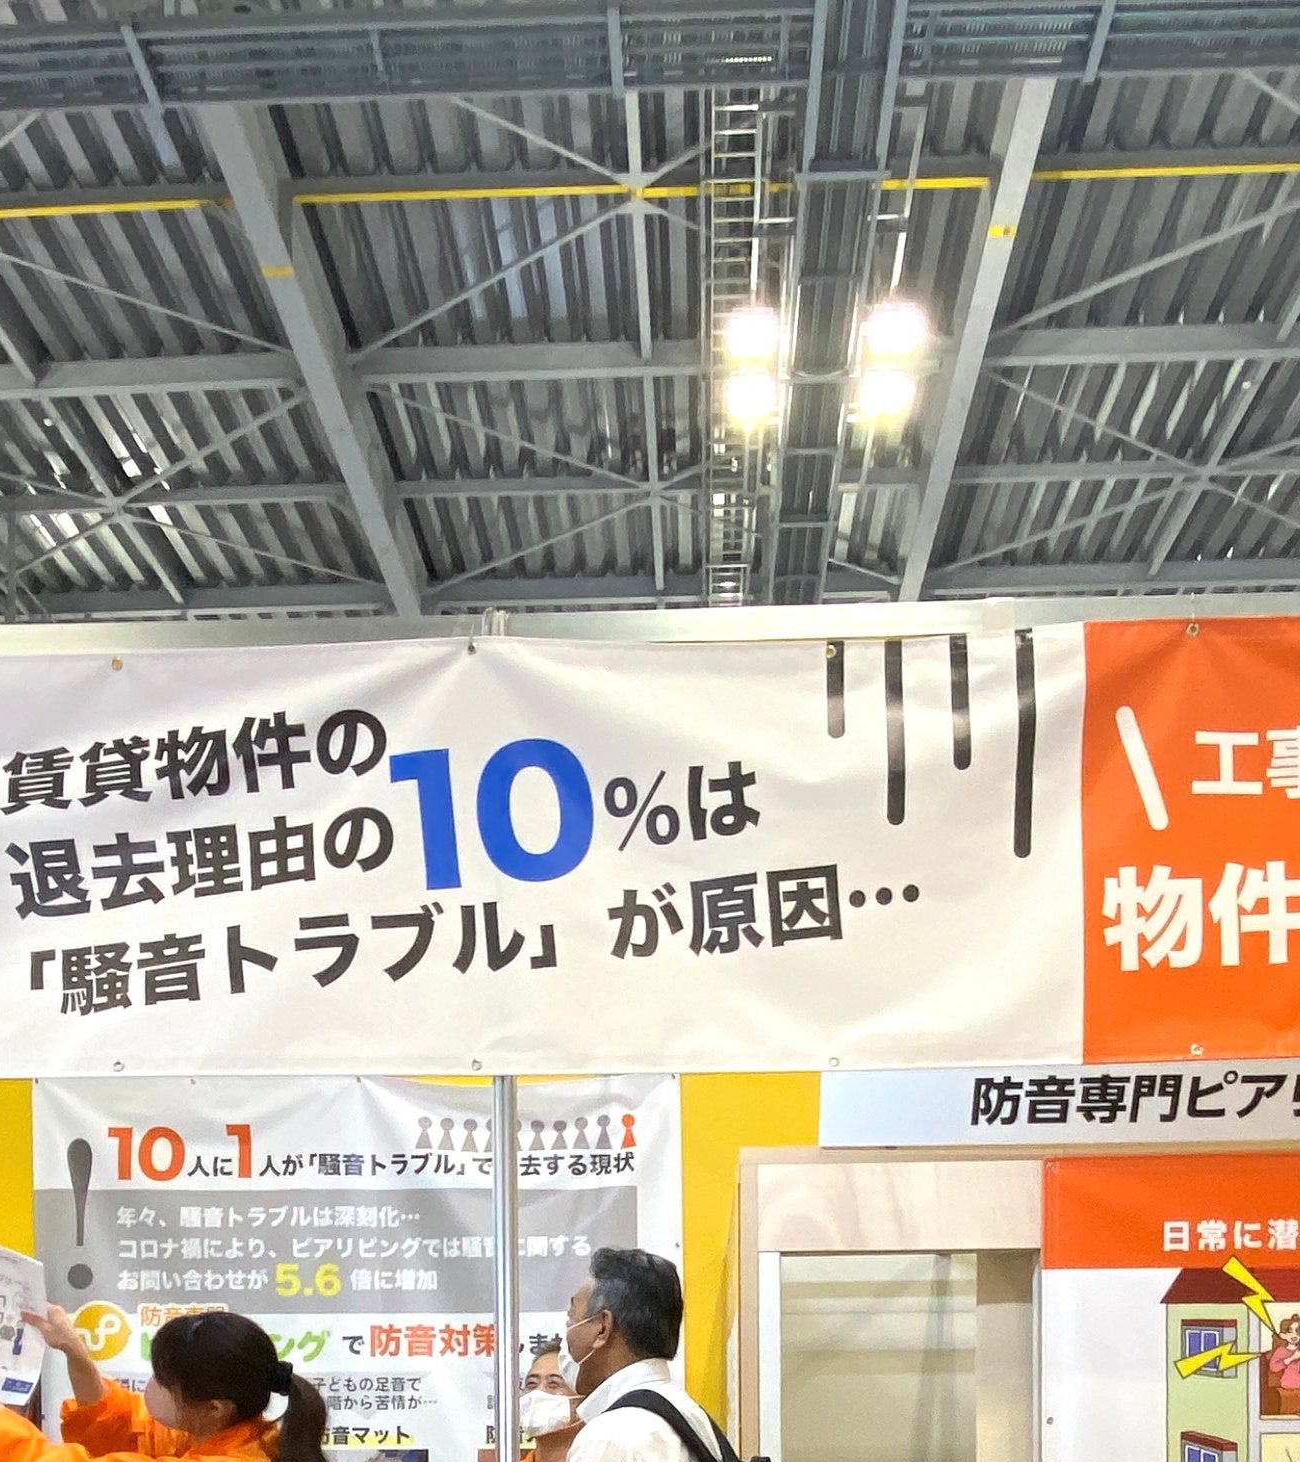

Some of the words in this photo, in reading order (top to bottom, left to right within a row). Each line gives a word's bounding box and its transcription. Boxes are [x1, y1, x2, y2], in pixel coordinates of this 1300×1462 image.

[0, 708, 387, 816] 賃貸物件の
[4, 806, 395, 920] 退去理由の
[107, 1123, 635, 1182] 10人に1人が「騒音トラブル」で去する現状
